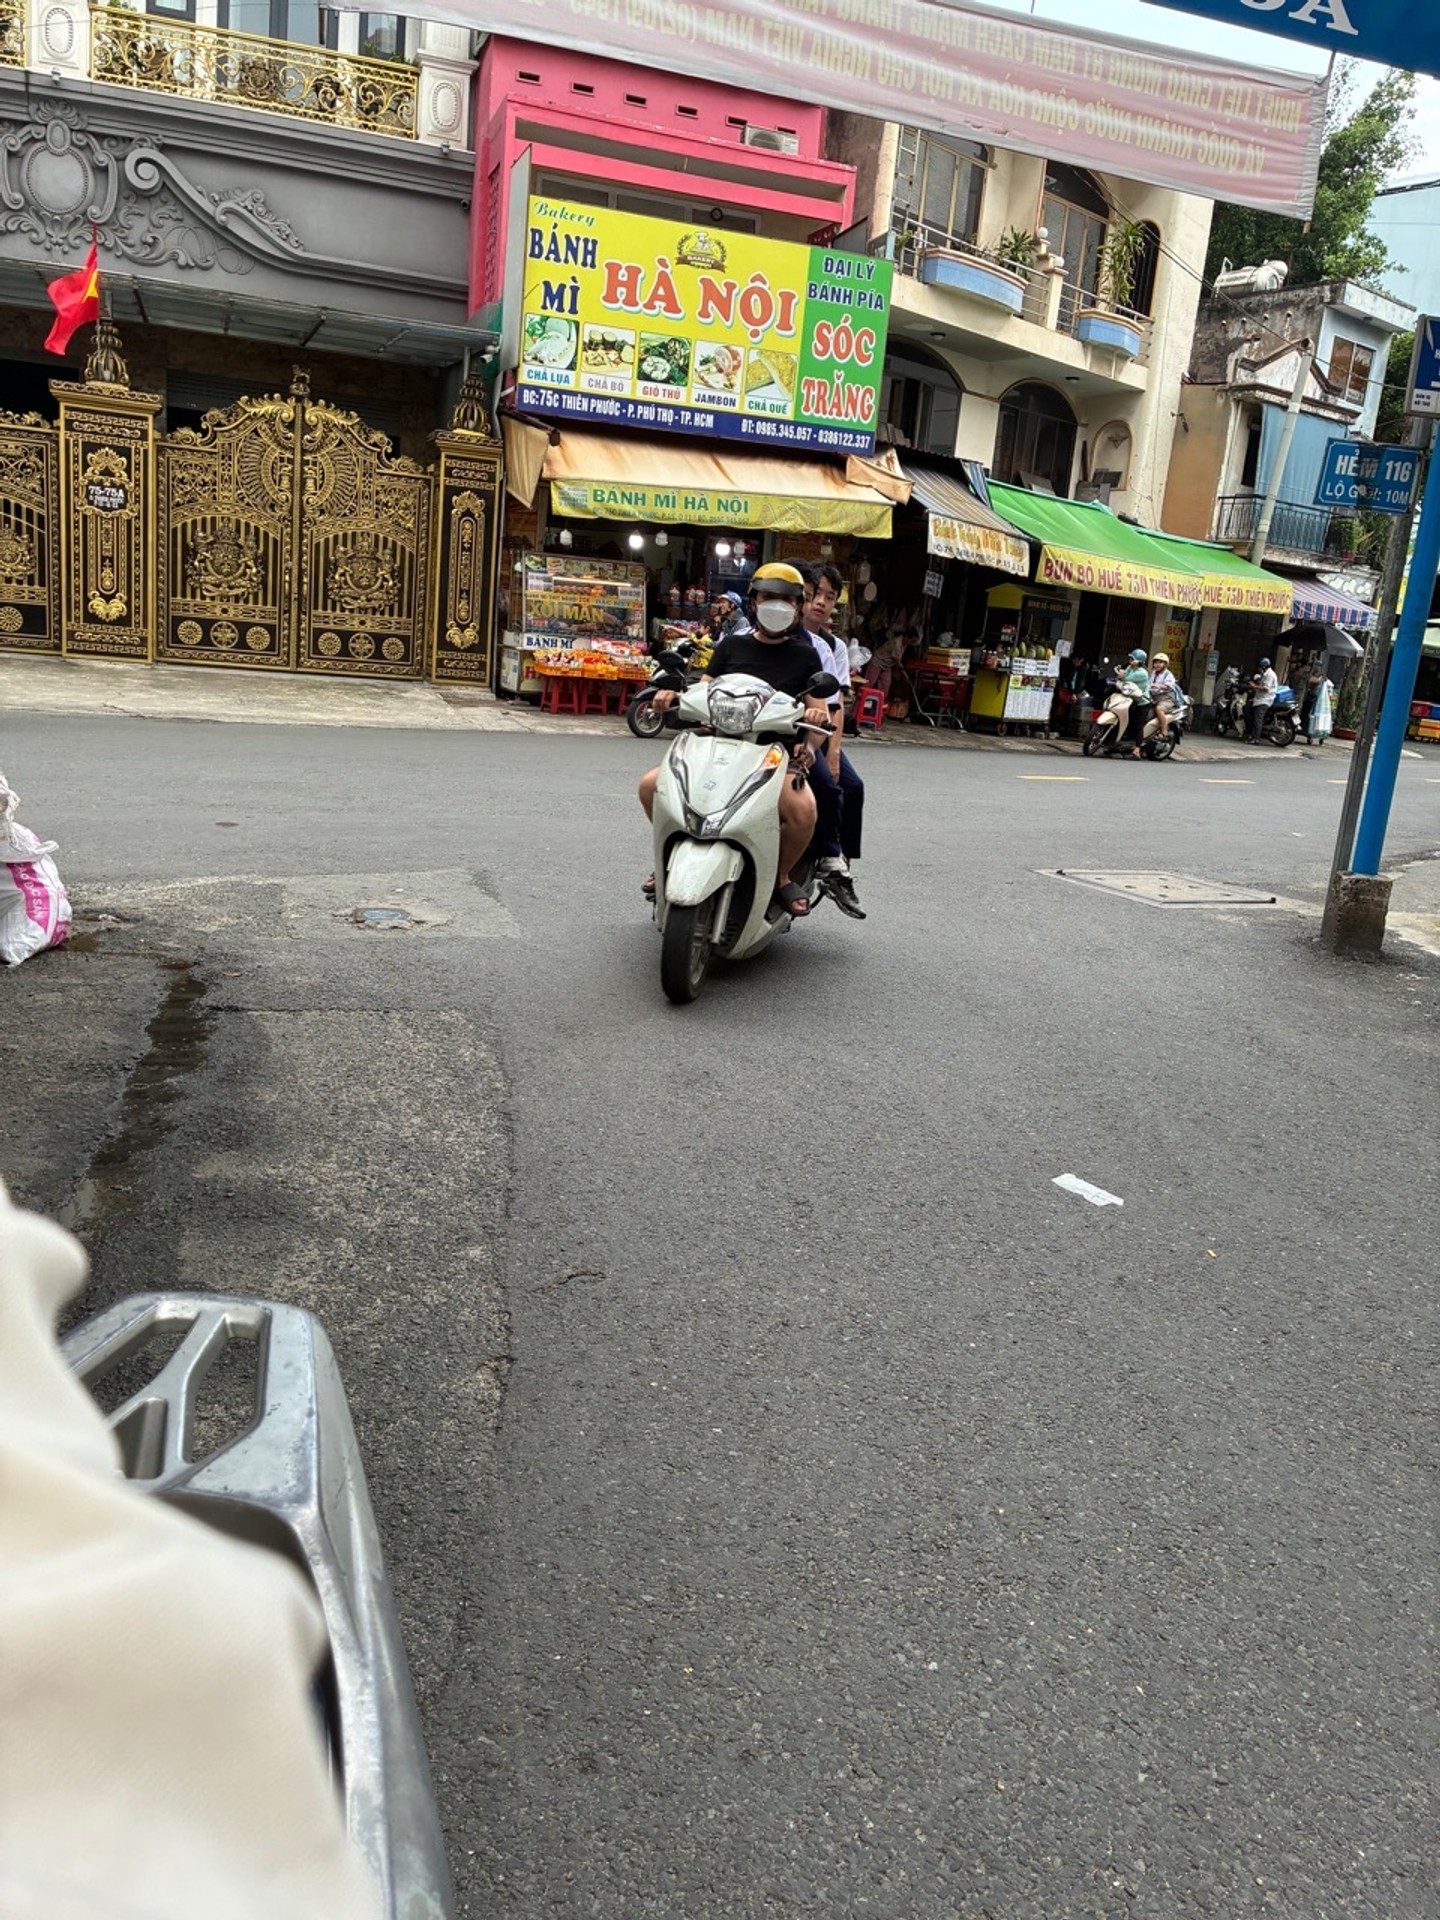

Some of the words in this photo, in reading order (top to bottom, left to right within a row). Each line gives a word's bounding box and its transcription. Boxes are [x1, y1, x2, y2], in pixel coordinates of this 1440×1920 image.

[534, 202, 595, 227] Bakery
[529, 223, 598, 269] BÁNH
[824, 257, 850, 279] ĐẠI
[856, 261, 875, 280] LÝ
[541, 276, 580, 315] MÌ
[601, 257, 684, 318] HÀ
[697, 273, 798, 340] NỘI
[808, 281, 853, 305] BÁNH
[857, 288, 884, 310] PÍA
[812, 314, 876, 365] SÓC
[527, 368, 548, 382] CHẢ
[550, 371, 570, 385] LỤA
[562, 394, 589, 411] THIÊN
[590, 397, 621, 416] PHƯỚC
[637, 404, 655, 421] PHÚ
[657, 408, 674, 426] THỌ
[680, 411, 692, 425] TP.
[694, 413, 714, 428] HCM
[694, 393, 737, 407] JAMBON
[802, 371, 874, 422] TRĂNG
[1335, 449, 1379, 479] HẺM
[1385, 460, 1412, 482] 116
[592, 486, 646, 507] BÁNH
[654, 490, 676, 509] MÌ
[684, 493, 709, 511] HÀ
[717, 495, 748, 516] NỘI
[1325, 480, 1345, 500] LỘ
[1386, 490, 1409, 505] 10M
[1044, 556, 1073, 582] BÚN
[1076, 561, 1094, 586] BÒ
[1098, 565, 1122, 590] HUẾ
[1149, 576, 1174, 600] THIÊN
[1203, 580, 1223, 603] HUẾ
[1245, 587, 1265, 608] THIÊN
[526, 634, 557, 648] BÁNH
